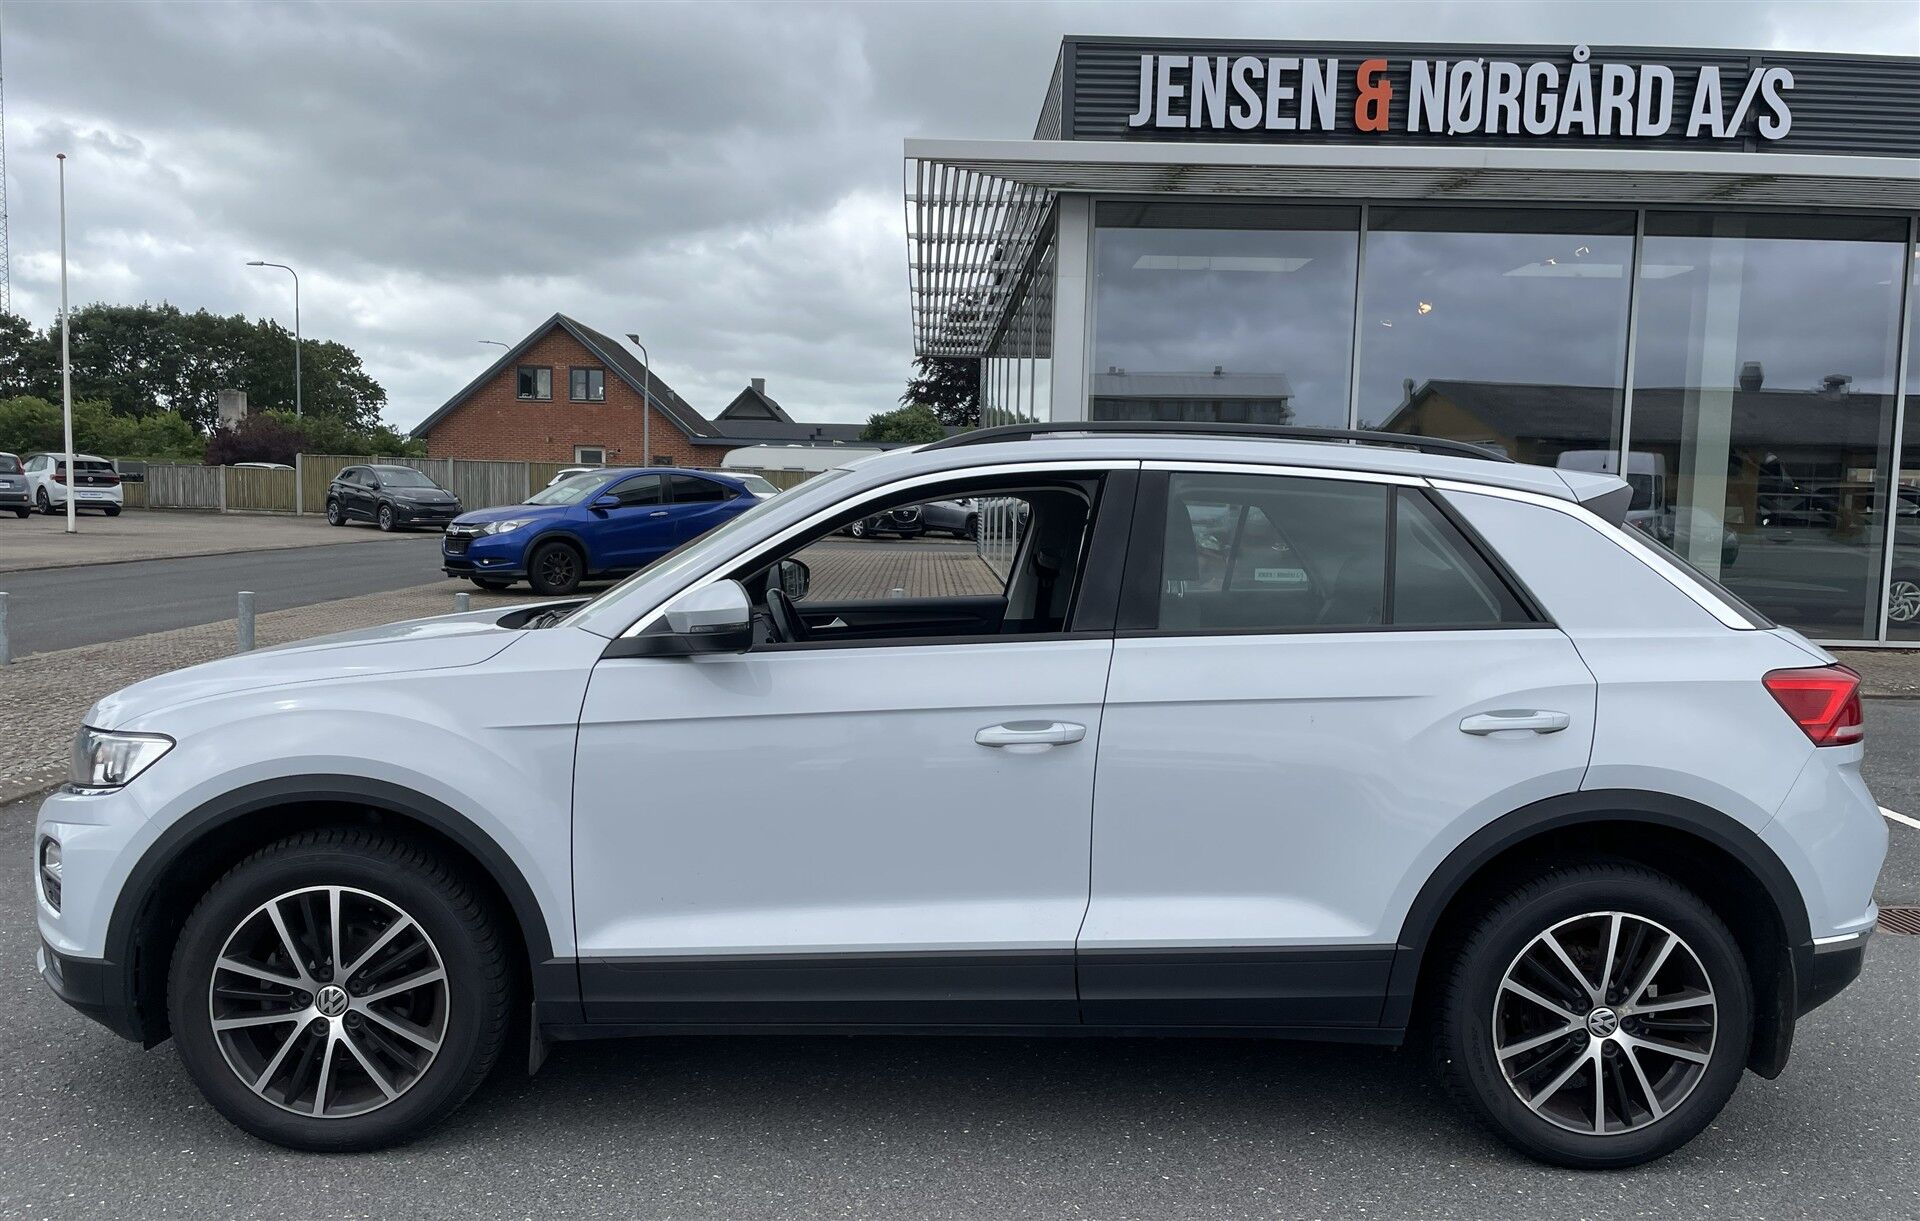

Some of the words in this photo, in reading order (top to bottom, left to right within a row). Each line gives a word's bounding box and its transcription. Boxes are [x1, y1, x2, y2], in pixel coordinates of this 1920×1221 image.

[1129, 54, 1339, 130] JENSEN
[1354, 58, 1393, 132] &
[1407, 44, 1675, 137] NØRGÅRD
[1686, 66, 1795, 140] A/S
